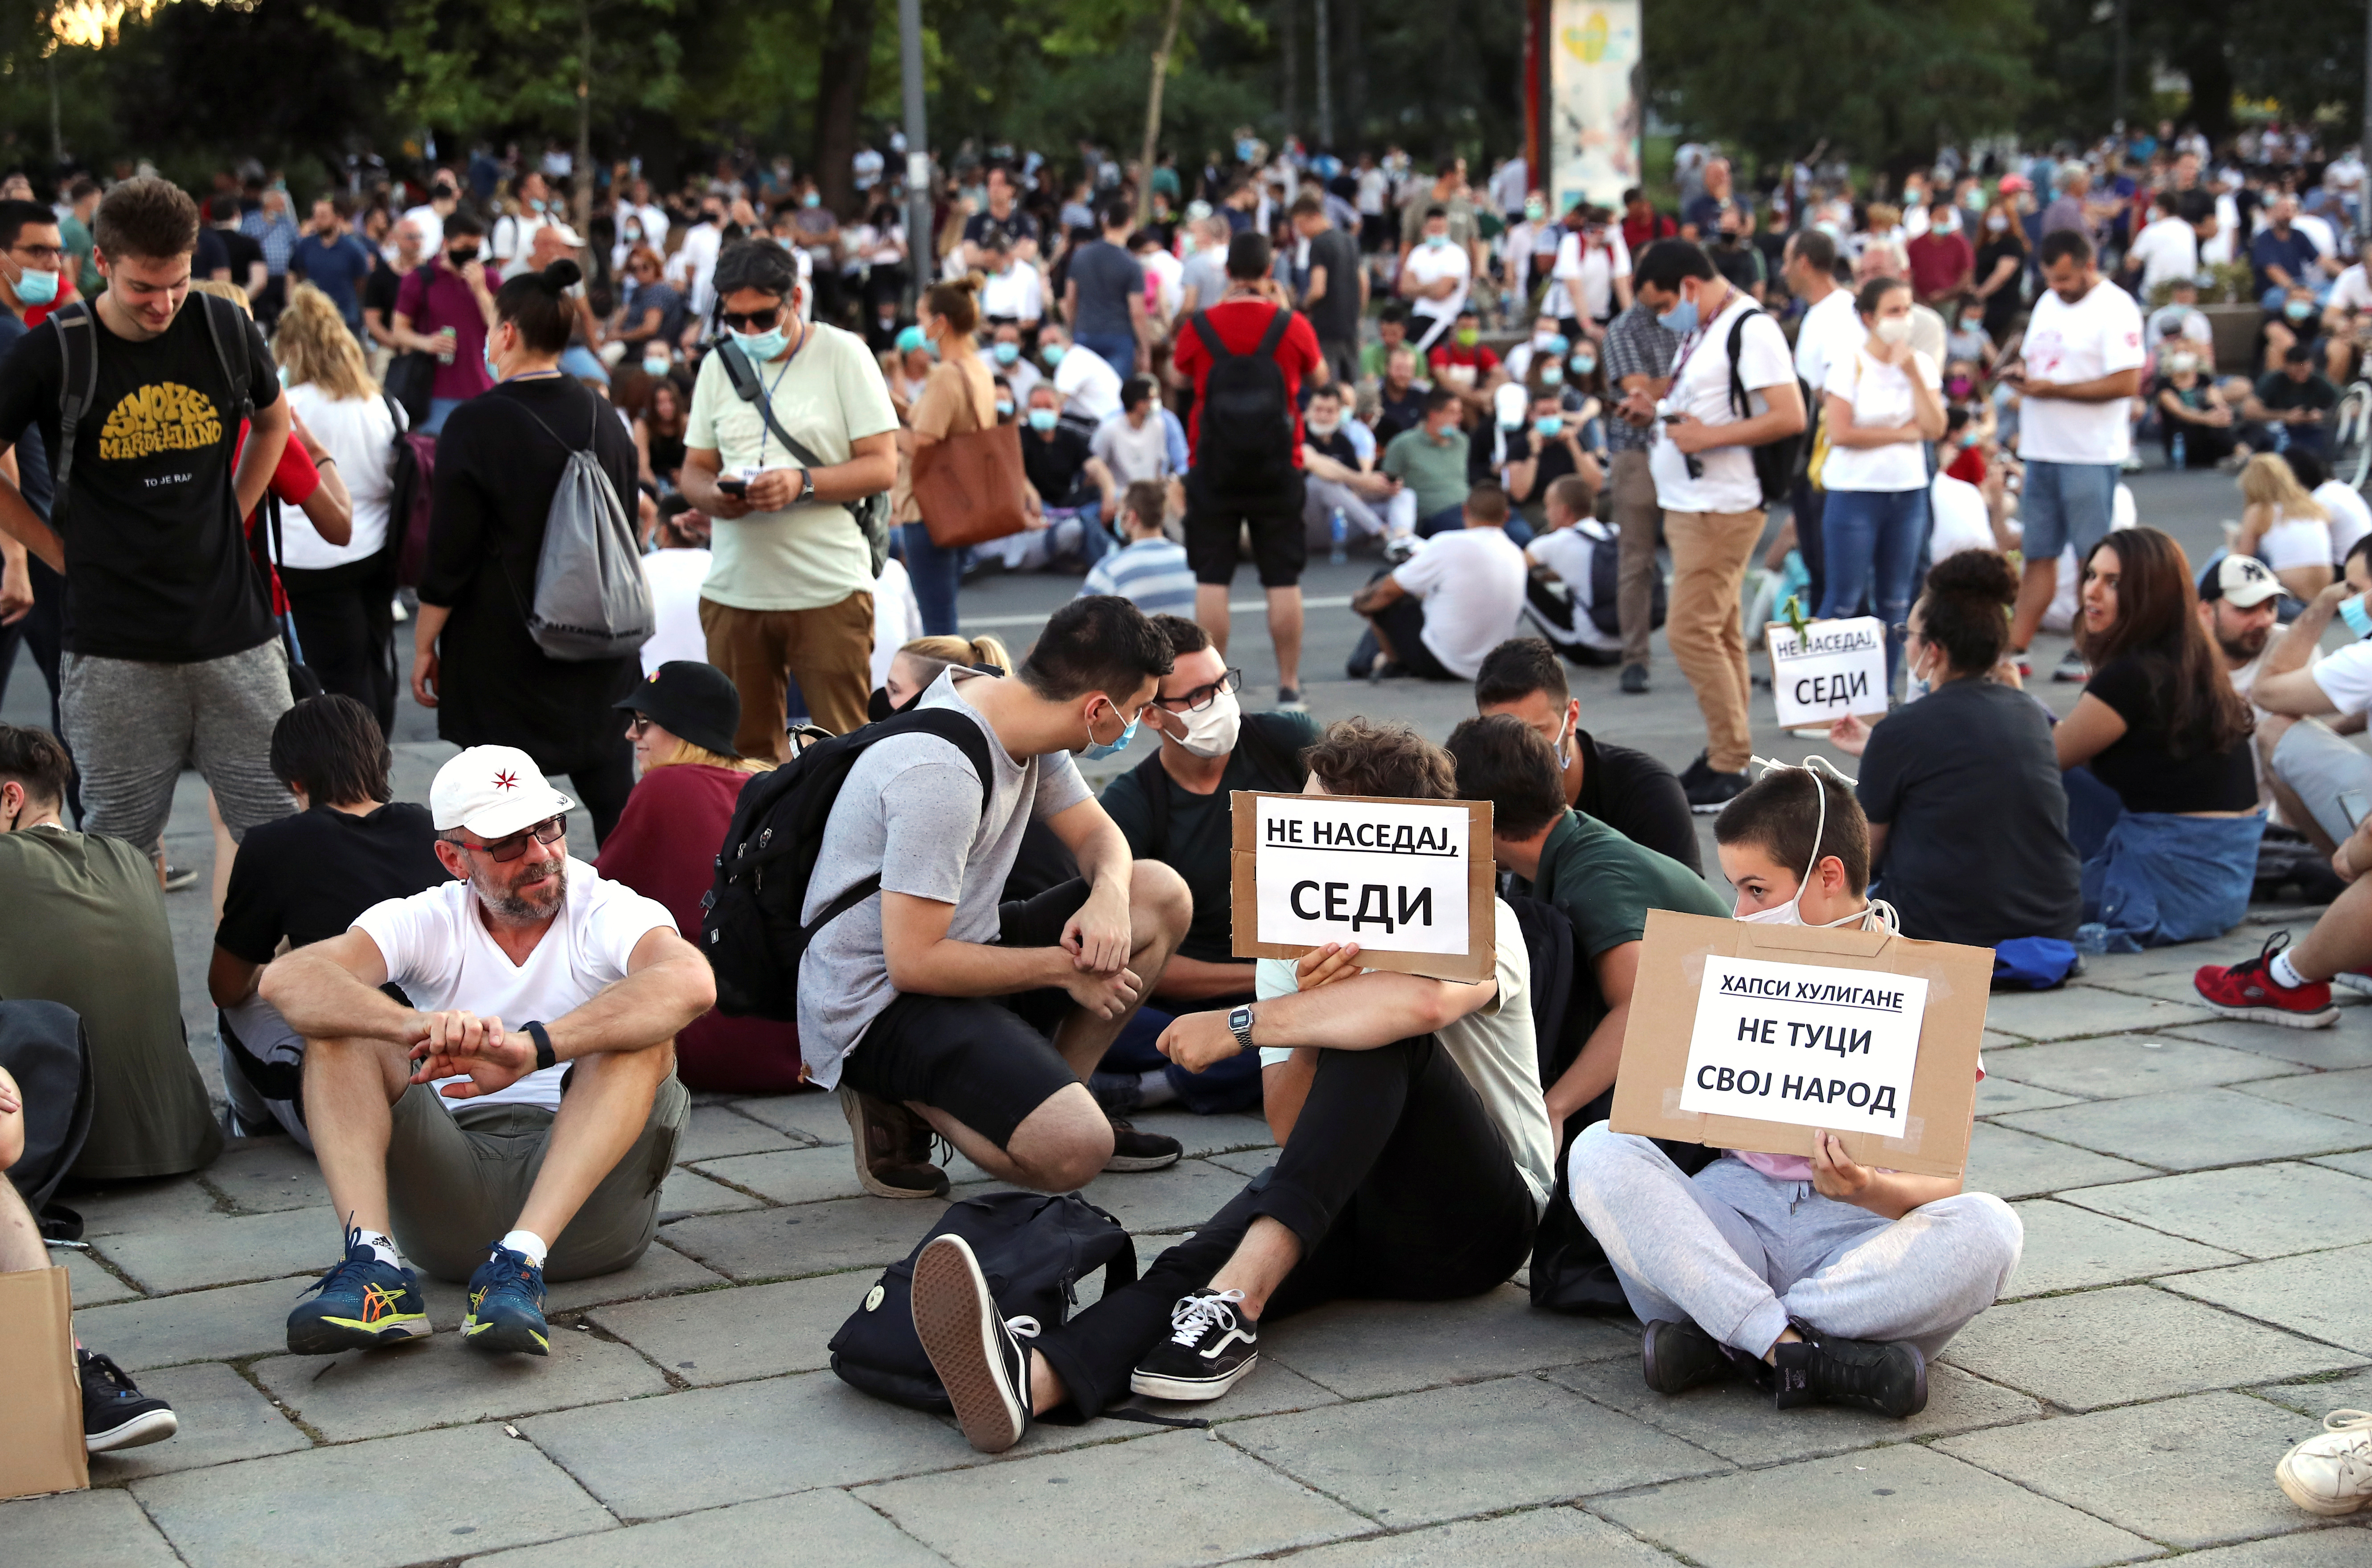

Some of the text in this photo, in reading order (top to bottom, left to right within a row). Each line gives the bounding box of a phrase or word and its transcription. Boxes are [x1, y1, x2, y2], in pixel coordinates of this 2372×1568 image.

[101, 381, 220, 439] SMOKE
[144, 472, 193, 488] TO JE RAP
[1776, 640, 1798, 657] НЕ
[1795, 670, 1868, 708] СЕДИ
[1268, 818, 1457, 856] НЕ НАСЕДАЈ,
[1290, 880, 1432, 934] СЕДИ
[1720, 975, 1904, 1009] ХАПСИ ХУЛИГАНЕ
[1737, 1017, 1872, 1058] НЕ ТУЦИ
[1697, 1065, 1896, 1118] СВОЈ НАРОД
